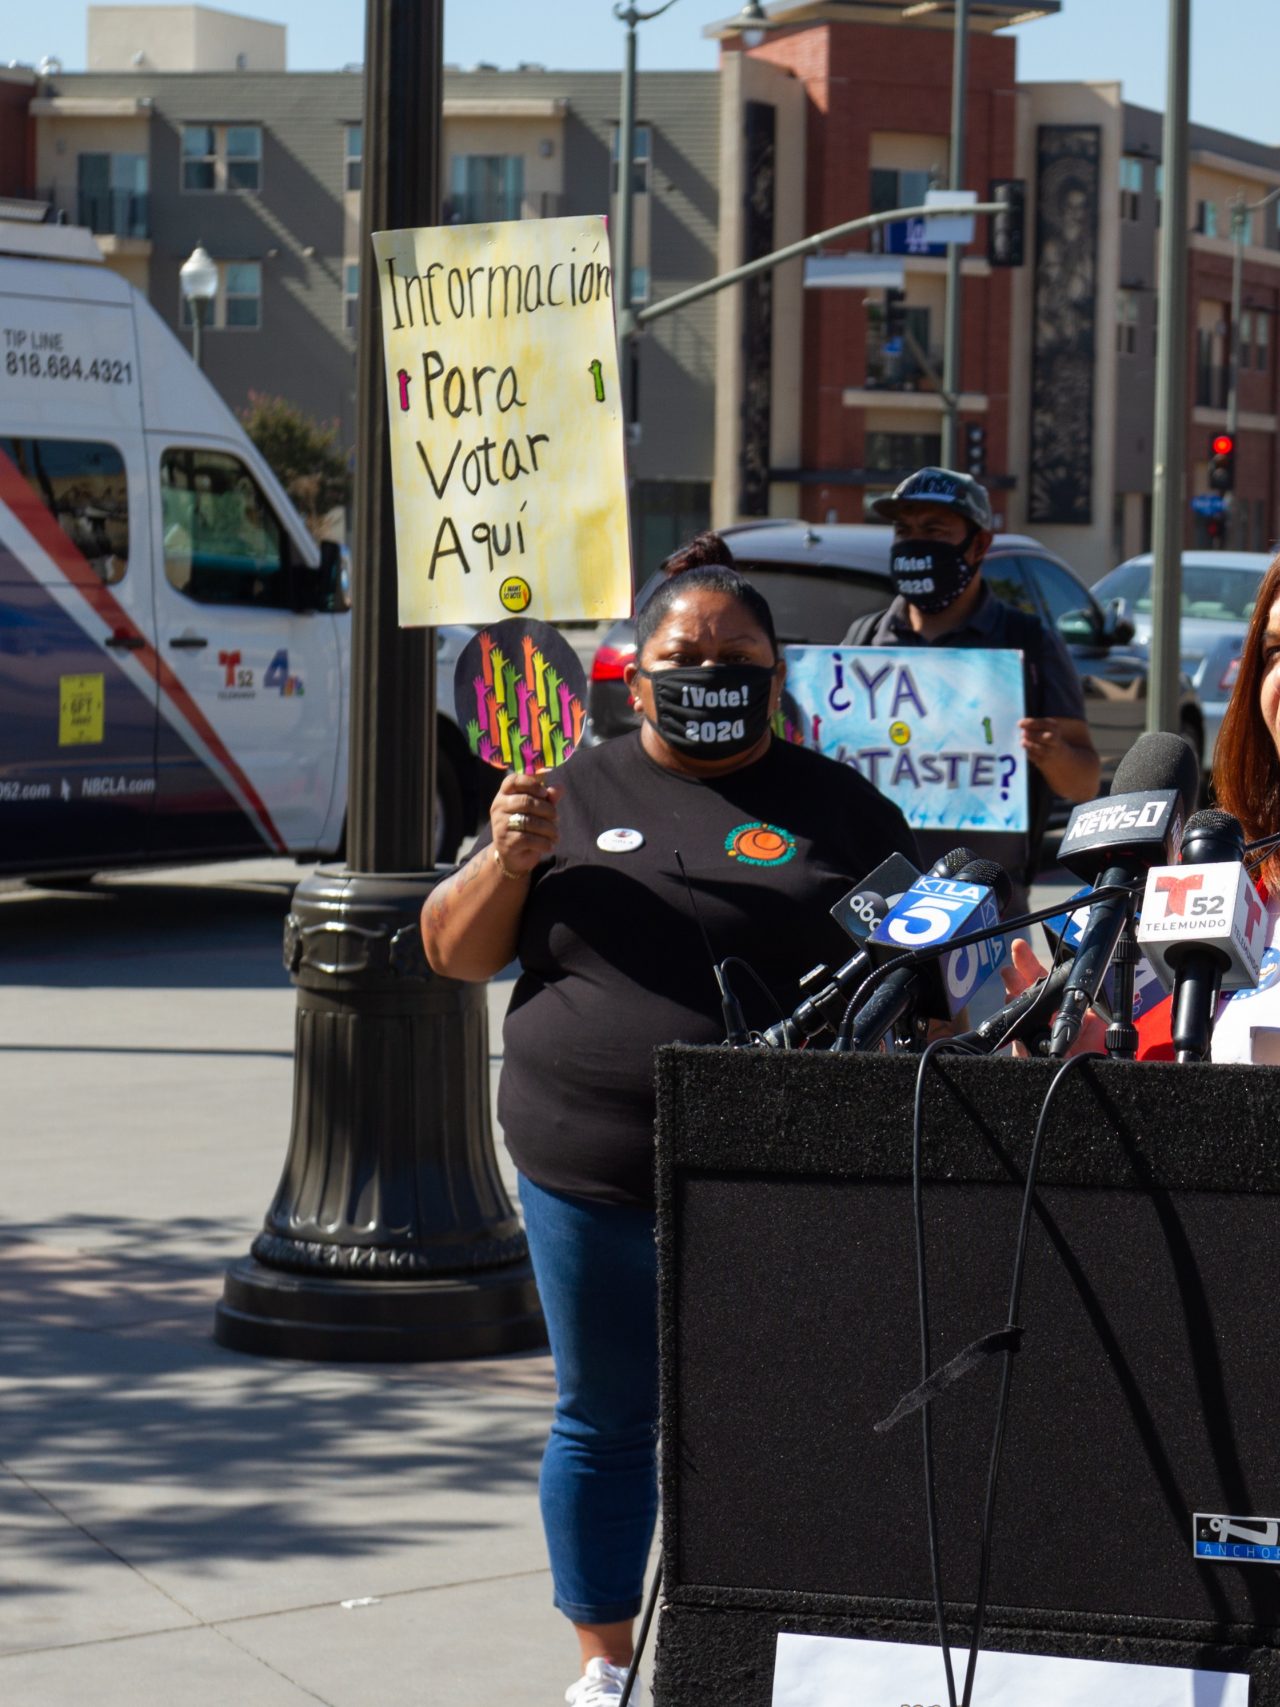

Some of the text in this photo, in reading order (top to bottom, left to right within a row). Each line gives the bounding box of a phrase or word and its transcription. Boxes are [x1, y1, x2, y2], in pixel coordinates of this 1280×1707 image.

[385, 241, 611, 330] Información
[4, 328, 63, 352] TIP LINE
[6, 351, 132, 384] 818.684.4321
[422, 351, 527, 420] Para
[416, 434, 549, 499] Votar
[428, 500, 527, 580] Aquí
[682, 685, 749, 708] ¡Vote!
[829, 652, 927, 720] ¿YA
[685, 719, 745, 742] 2020
[82, 776, 156, 798] NBCLA.com
[1068, 809, 1140, 840] NEWS
[915, 877, 980, 900] KTLA
[850, 895, 882, 933] abc
[888, 896, 963, 945] 5
[1190, 895, 1225, 915] 52
[1146, 919, 1227, 931] TELEMUNDO
